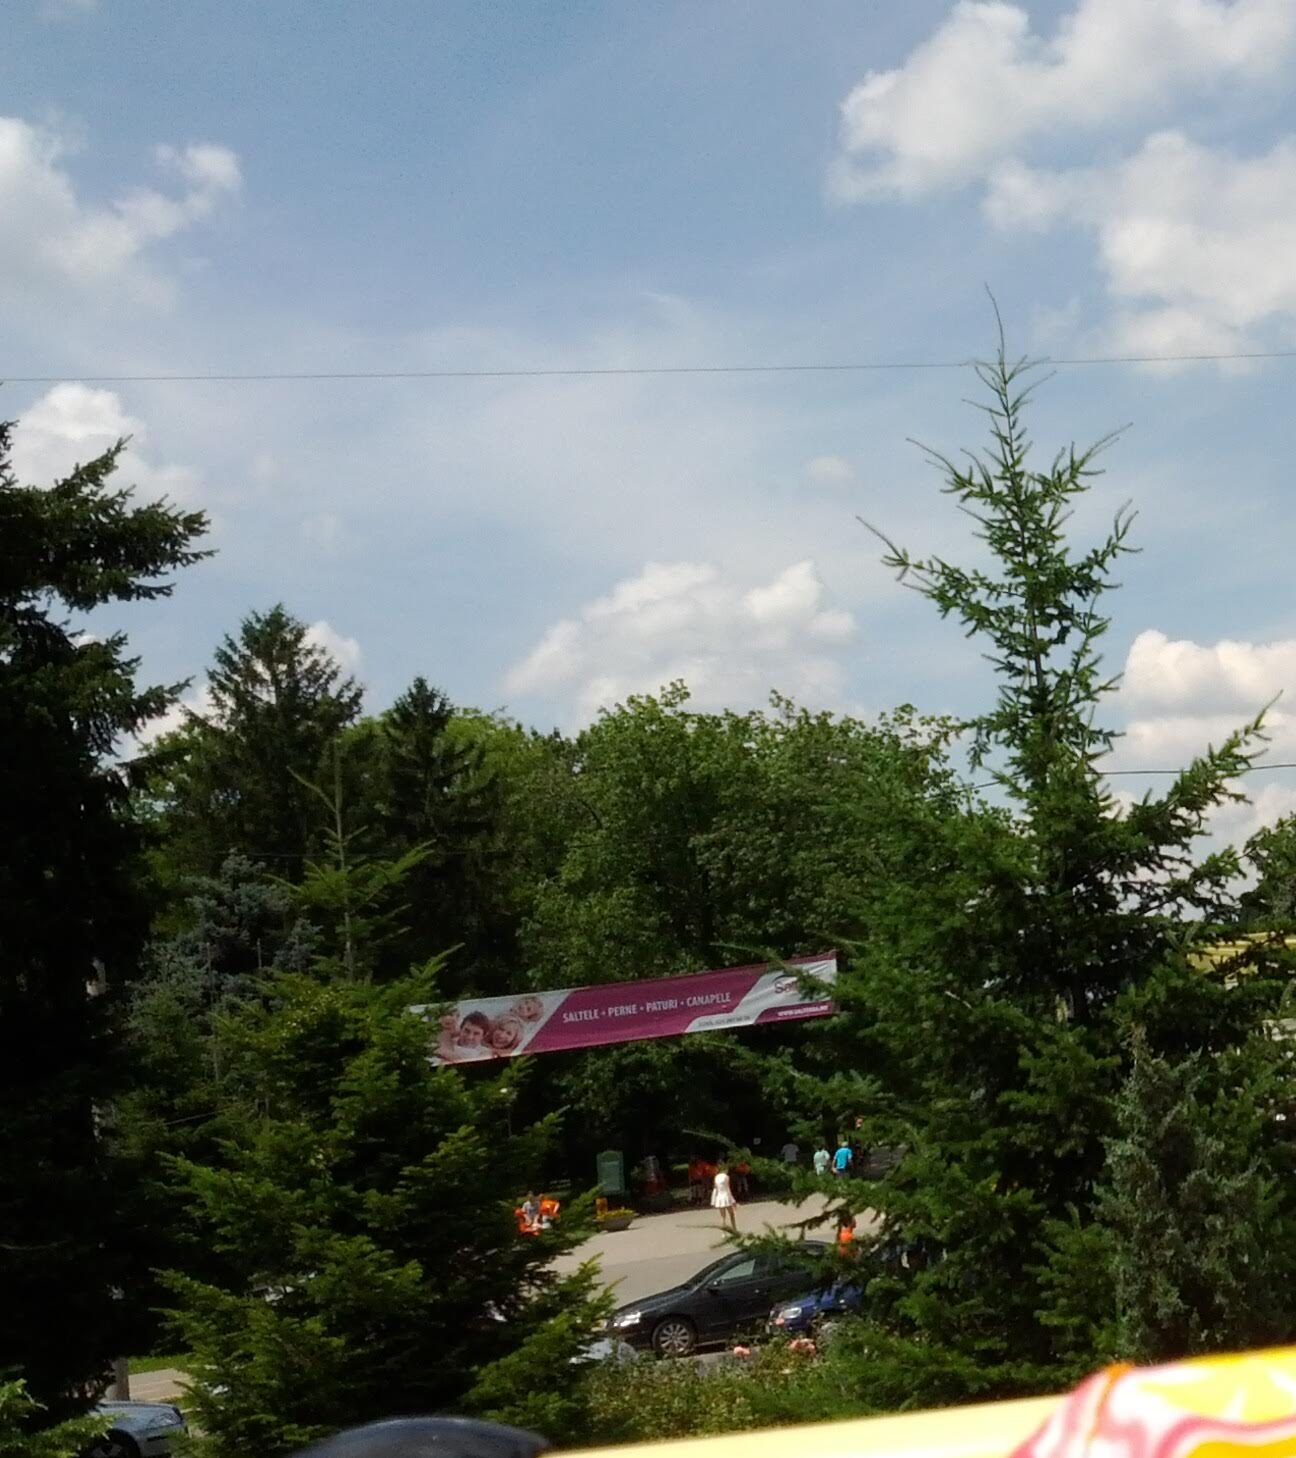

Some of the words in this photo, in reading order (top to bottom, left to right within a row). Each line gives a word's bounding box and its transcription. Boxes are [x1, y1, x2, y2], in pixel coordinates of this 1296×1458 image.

[563, 1008, 599, 1023] SALTELE
[608, 1004, 638, 1017] PERNE
[646, 999, 678, 1012] PATURI
[687, 992, 731, 1006] CANAPELE
